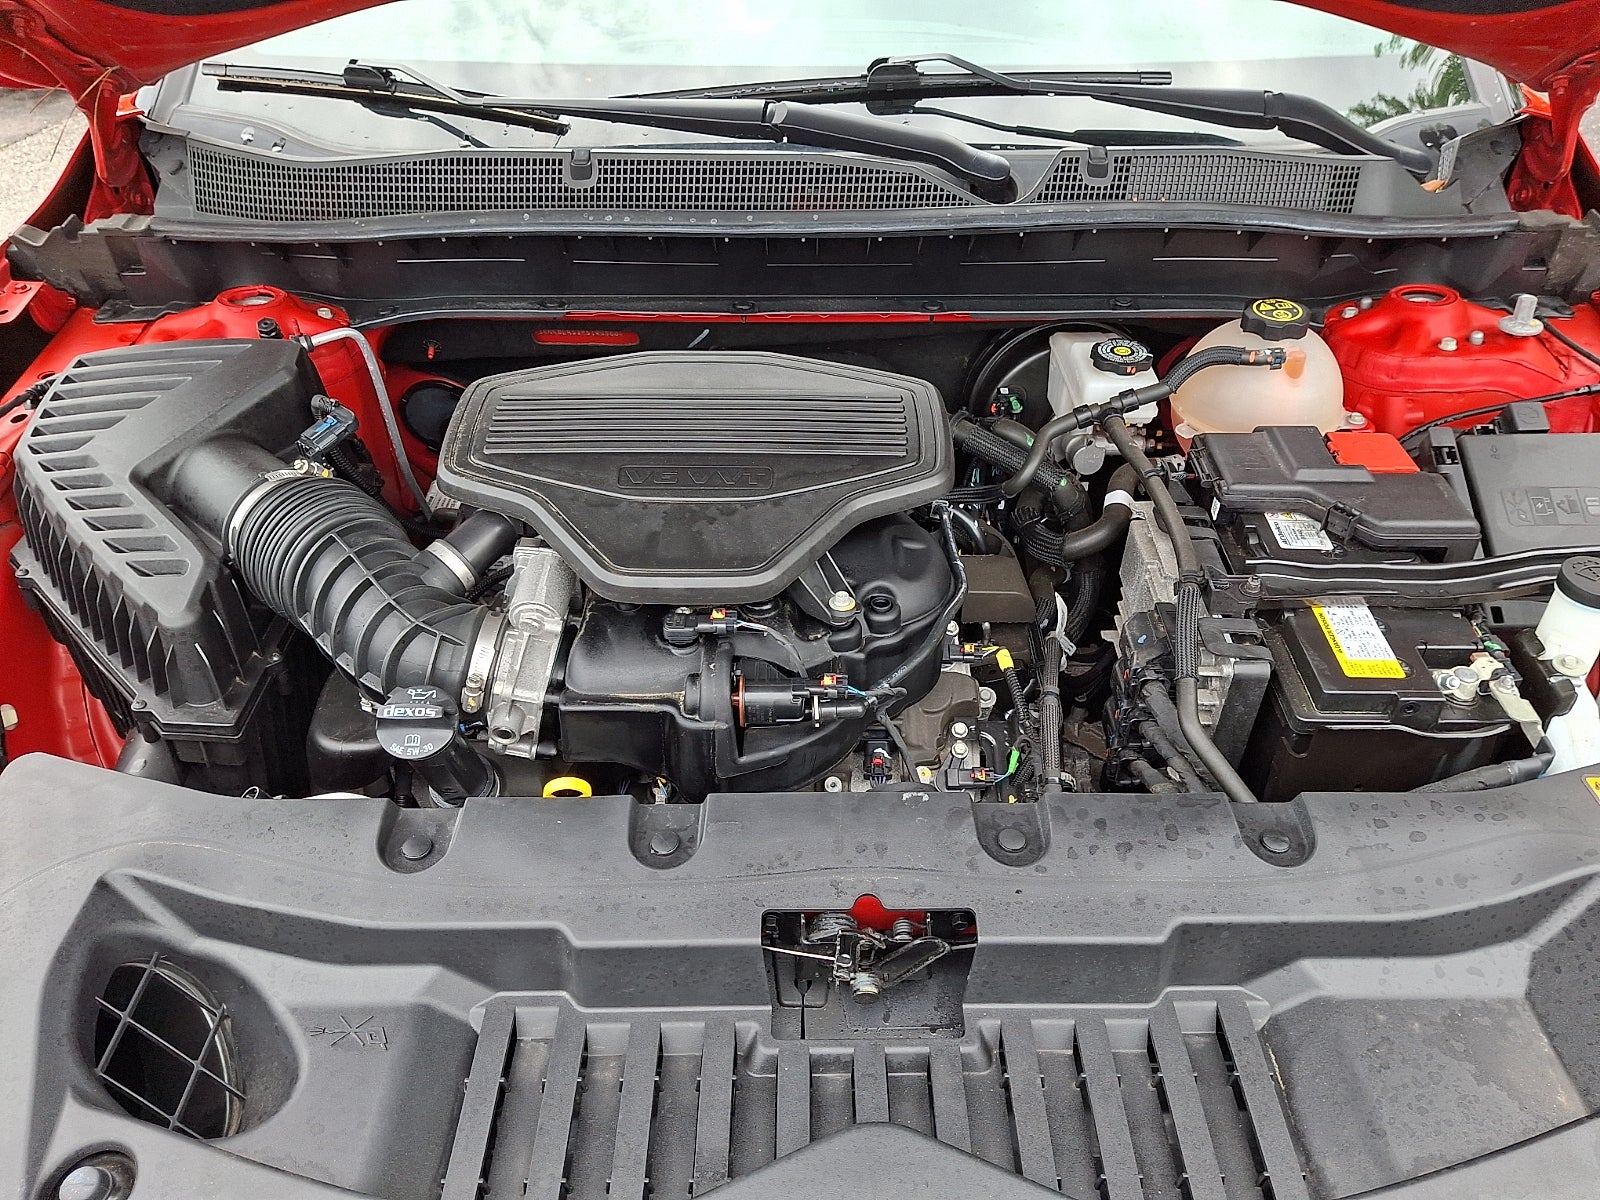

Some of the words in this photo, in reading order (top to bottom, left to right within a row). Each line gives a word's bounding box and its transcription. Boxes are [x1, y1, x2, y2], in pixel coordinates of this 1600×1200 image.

[625, 469, 678, 484] V6
[687, 470, 766, 485] VVT
[383, 705, 437, 717] dexos
[390, 743, 405, 755] SAE
[406, 743, 433, 755] 5W-30
